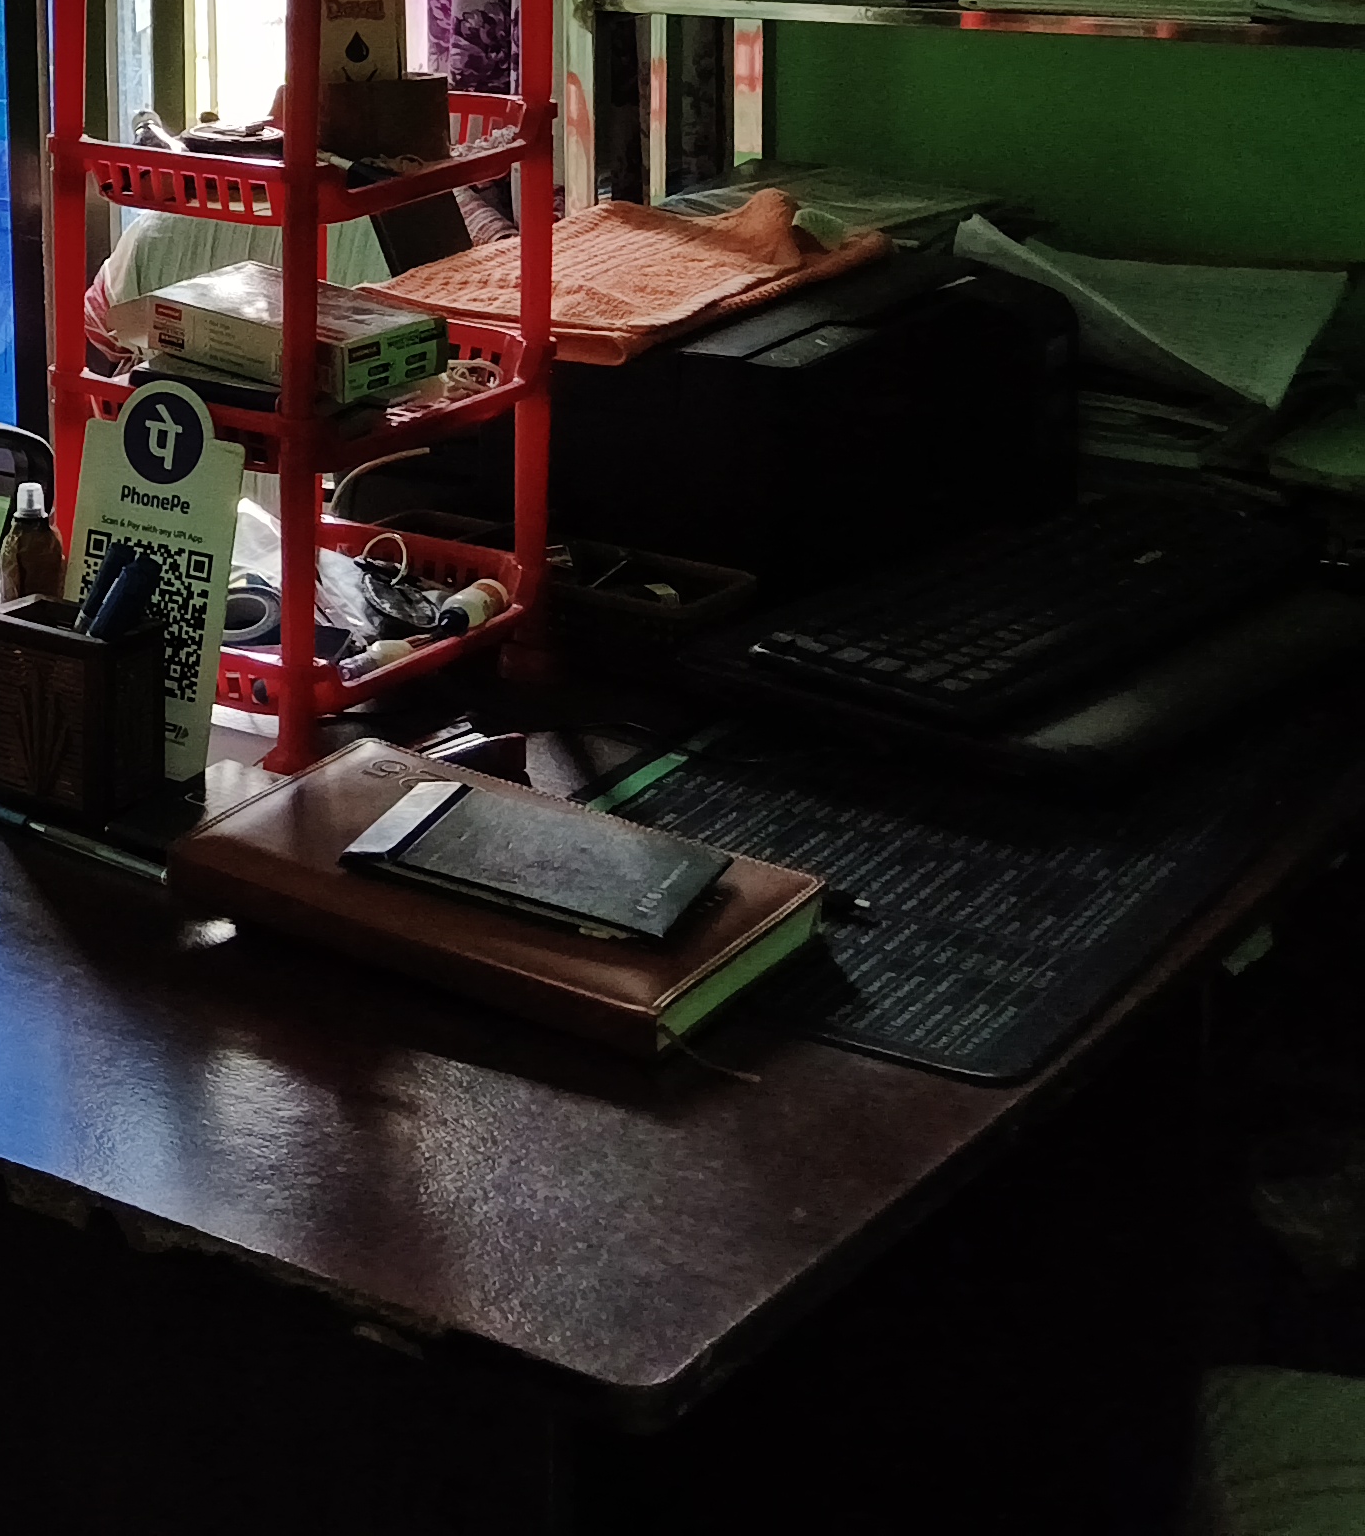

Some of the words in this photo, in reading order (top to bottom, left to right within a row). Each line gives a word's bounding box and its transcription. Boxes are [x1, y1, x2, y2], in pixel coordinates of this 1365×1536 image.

[145, 404, 183, 470] पे
[120, 485, 191, 514] PhonePe
[127, 519, 141, 531] Pay
